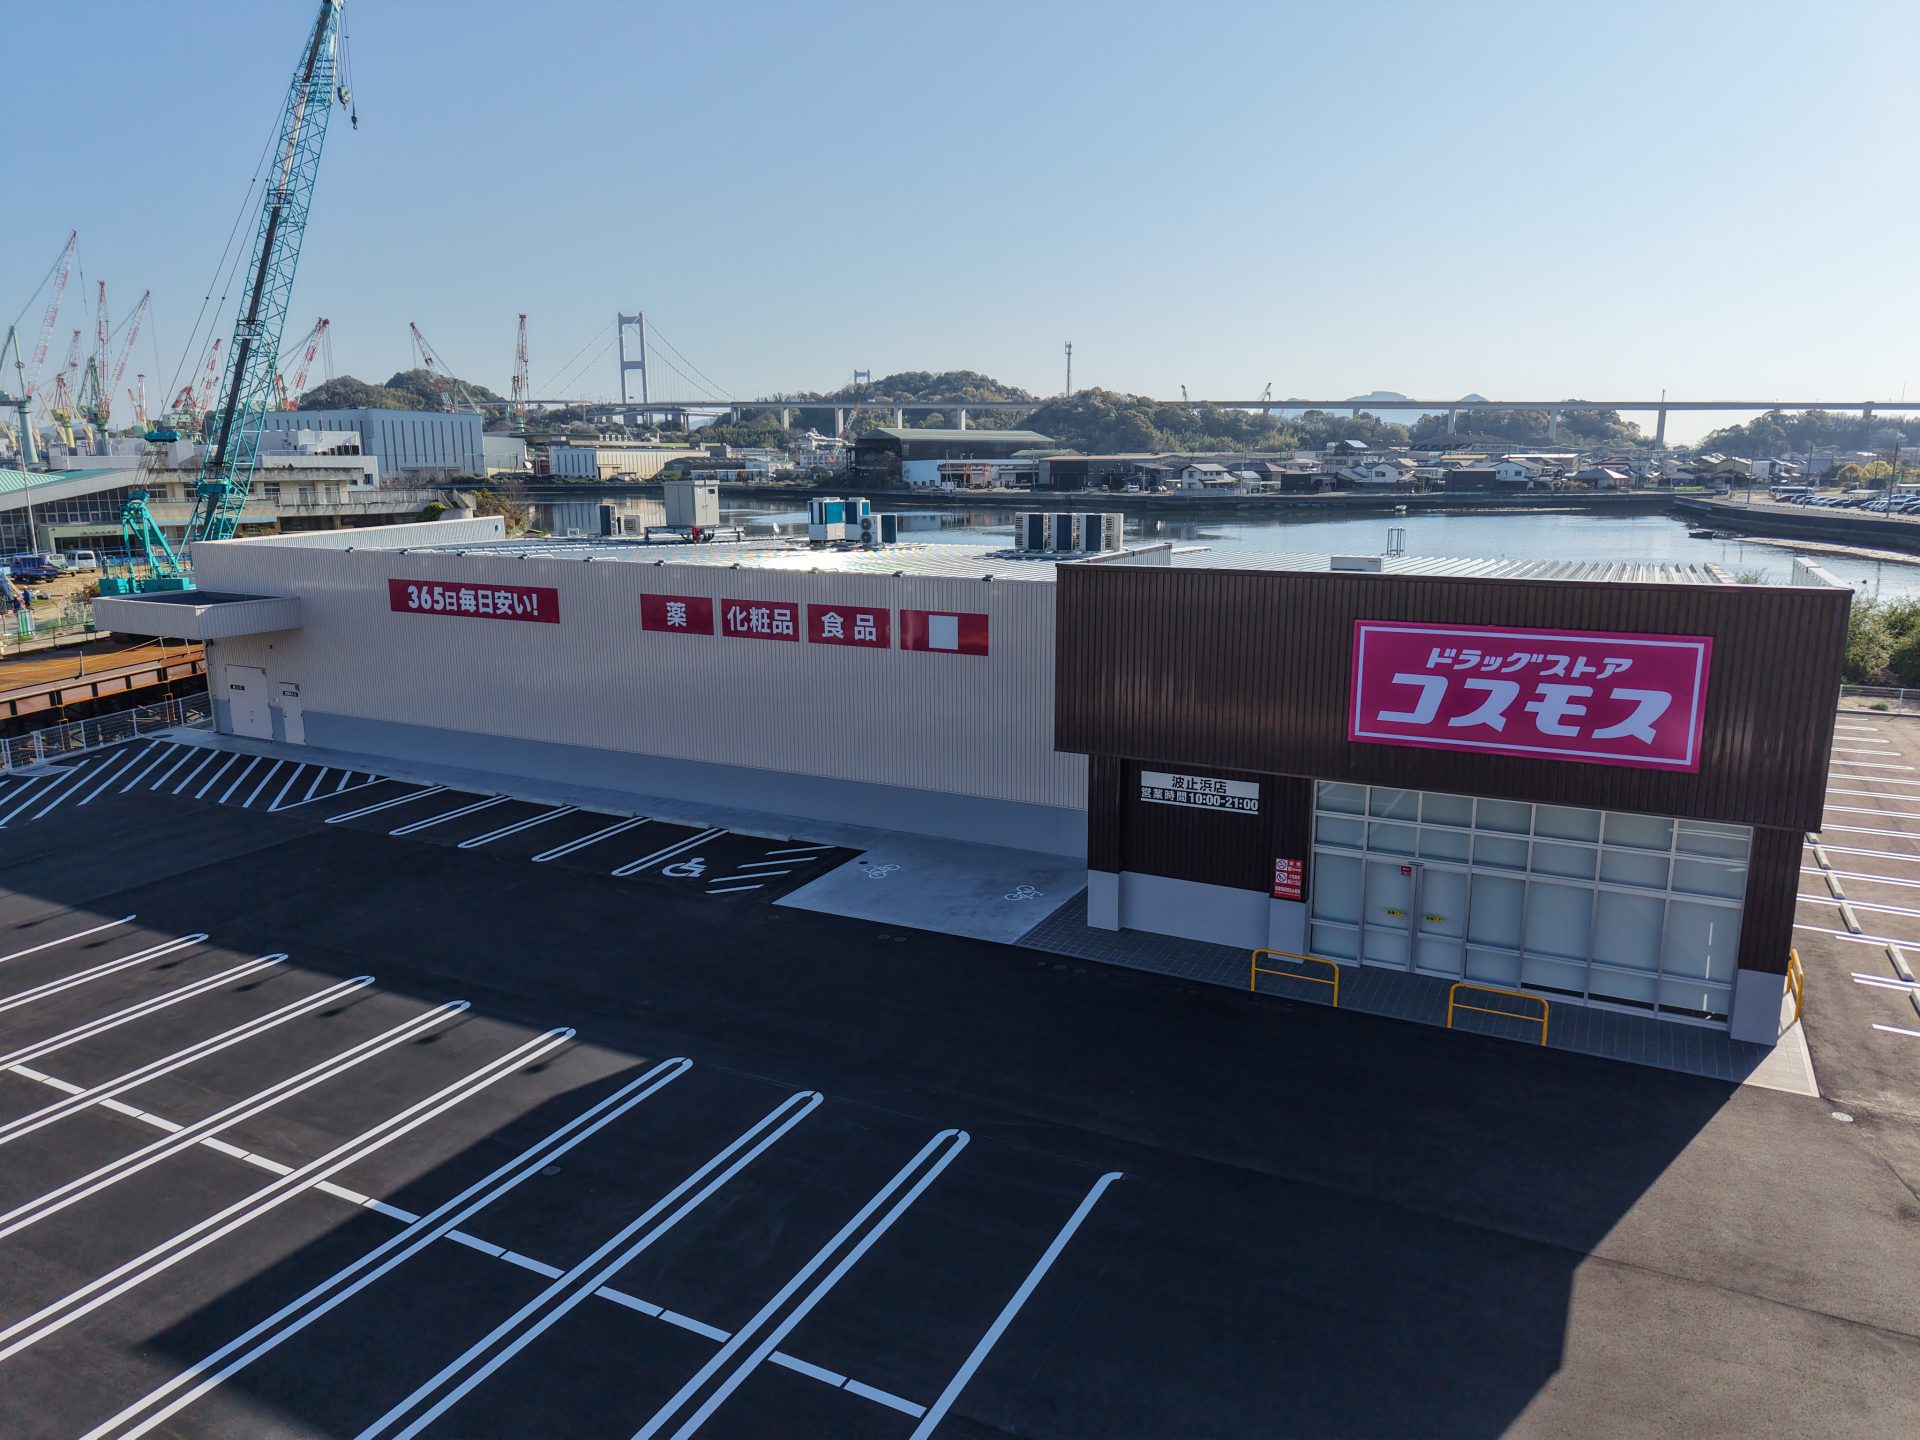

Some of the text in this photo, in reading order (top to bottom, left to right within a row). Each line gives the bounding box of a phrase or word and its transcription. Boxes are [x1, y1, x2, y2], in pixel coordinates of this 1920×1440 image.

[407, 585, 539, 616] 365日毎日安い!
[666, 601, 687, 627] 薬
[727, 605, 794, 635] 化粧品
[821, 611, 877, 642] 食品
[1425, 647, 1633, 679] ドラッグストア
[1376, 672, 1673, 745] コスモス
[1171, 775, 1227, 795] 波止浜店
